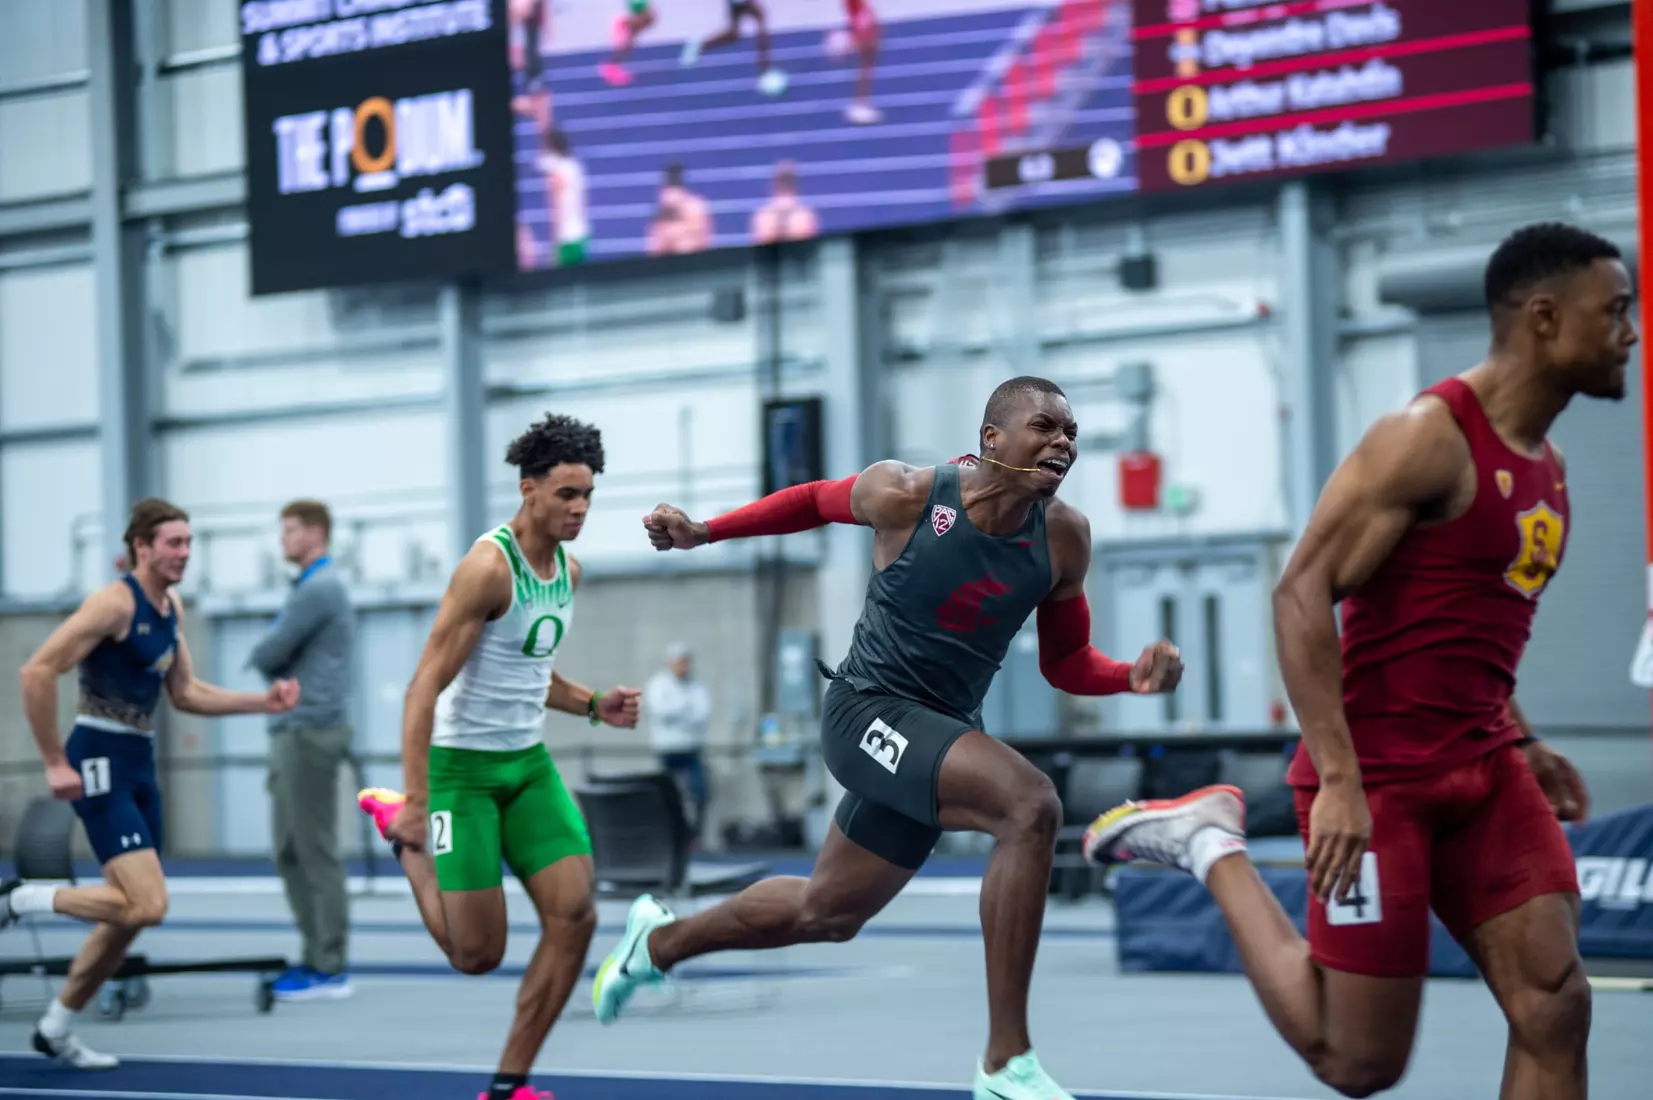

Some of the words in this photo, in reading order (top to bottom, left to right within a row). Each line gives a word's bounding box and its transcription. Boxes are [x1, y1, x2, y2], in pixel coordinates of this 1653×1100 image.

[935, 519, 949, 531] 12
[522, 614, 563, 658] O
[866, 729, 900, 767] 3
[88, 762, 101, 793] 1
[435, 815, 447, 851] 2
